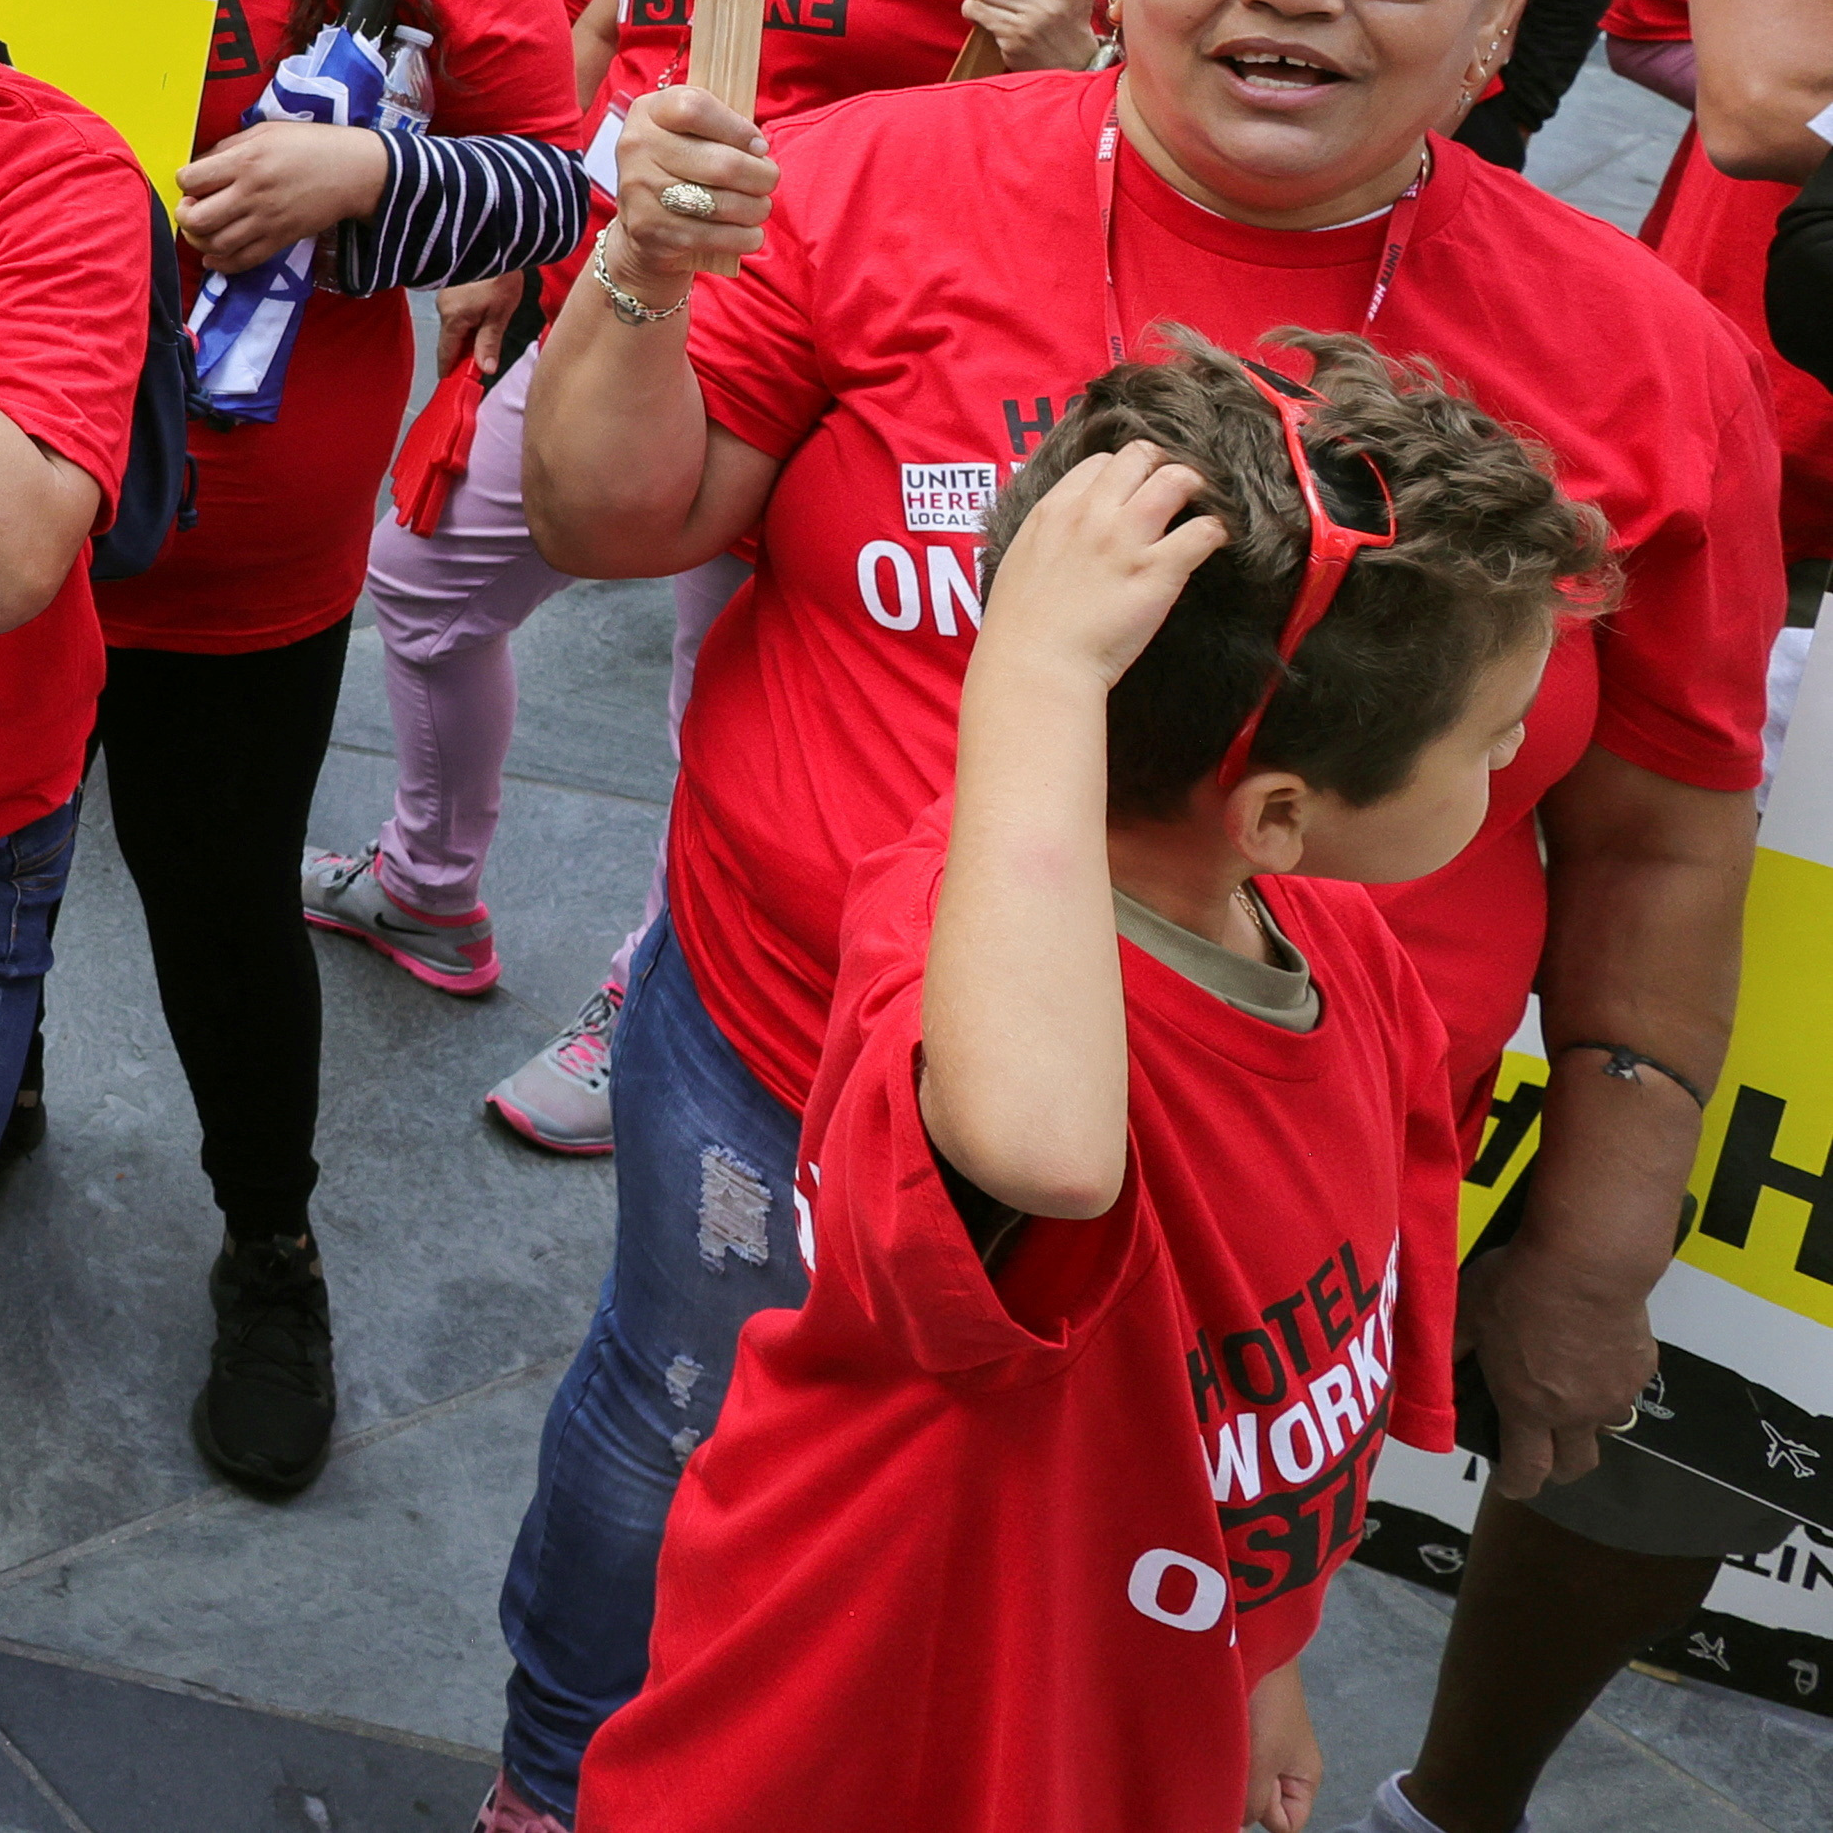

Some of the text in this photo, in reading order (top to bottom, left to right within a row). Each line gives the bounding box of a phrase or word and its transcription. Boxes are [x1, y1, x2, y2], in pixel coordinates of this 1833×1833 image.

[905, 468, 994, 490] UNITE
[909, 512, 971, 526] LOCAL
[1185, 1238, 1387, 1422] HOTEL
